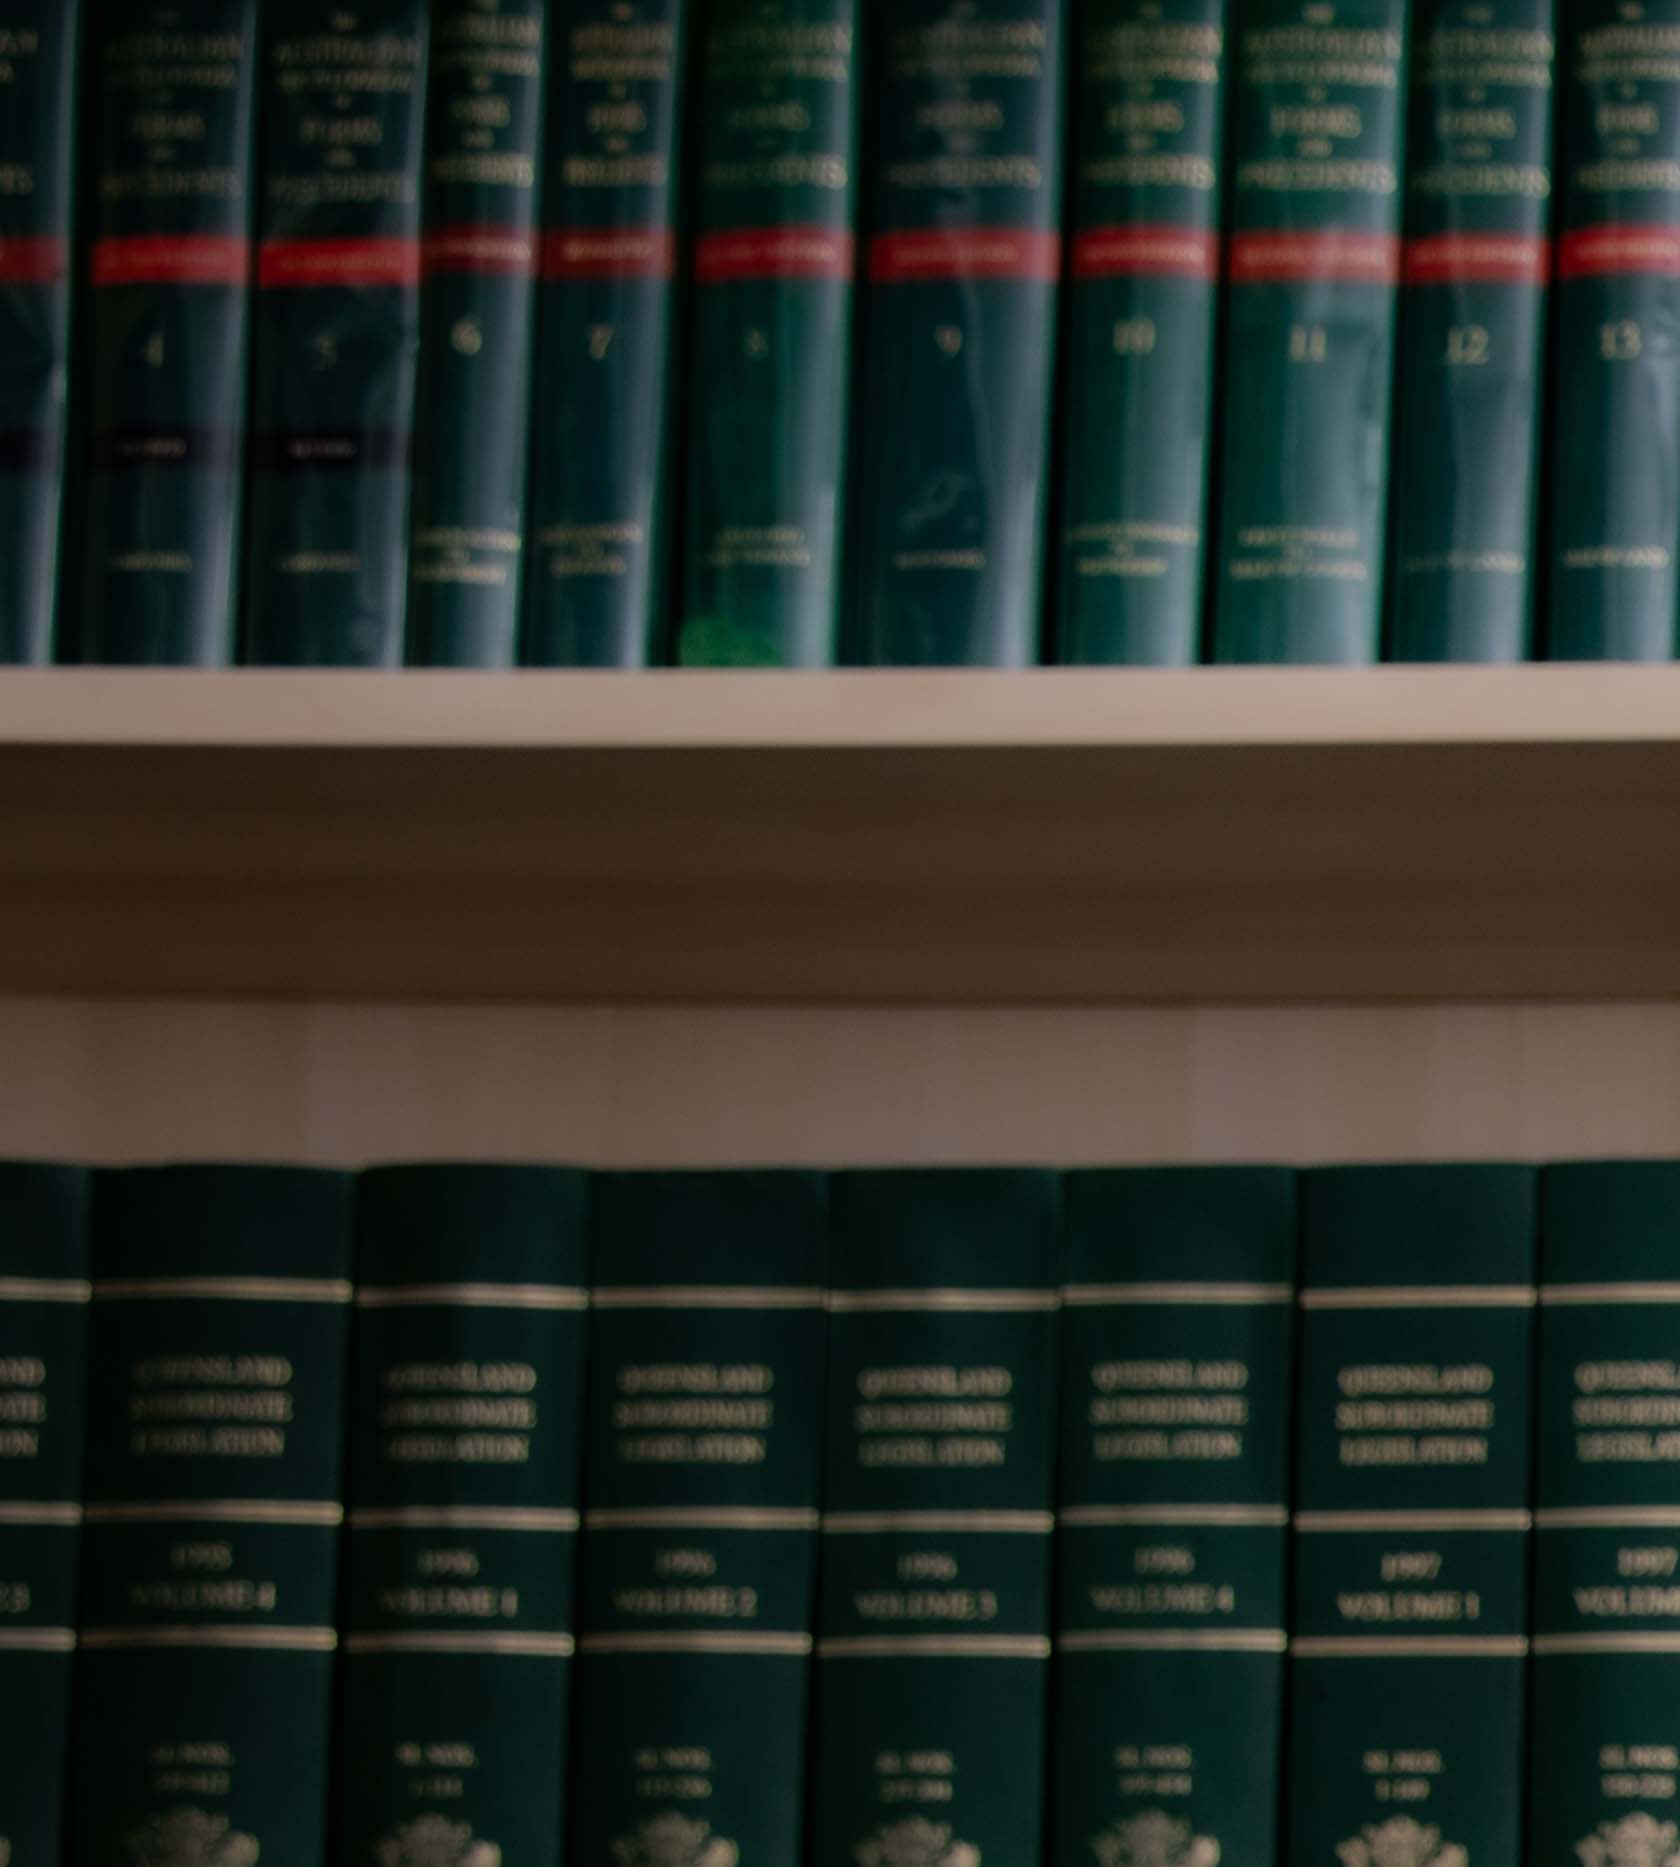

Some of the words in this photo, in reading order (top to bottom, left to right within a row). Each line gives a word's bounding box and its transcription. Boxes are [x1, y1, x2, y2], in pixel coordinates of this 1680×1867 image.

[450, 316, 483, 357] 6
[587, 323, 615, 360] 7
[933, 324, 962, 357] 9
[1113, 320, 1155, 354] 10
[1290, 325, 1326, 363] 11
[1447, 325, 1490, 365] 12
[1600, 321, 1641, 359] 13
[616, 1362, 774, 1393] QUEENSLAND
[857, 1365, 1012, 1398] QUEENSLAND
[1090, 1359, 1248, 1391] QUEENSLAND
[1337, 1363, 1494, 1396] QUEENSLAND
[1093, 1430, 1242, 1460] LEGISLATION
[1339, 1435, 1488, 1466] LEGISLATION
[1380, 1552, 1442, 1582] 1997
[1616, 1545, 1679, 1577] 1997
[610, 1586, 737, 1617] VOLUME
[738, 1586, 758, 1617] 2
[852, 1590, 975, 1620] VOLUME
[977, 1589, 998, 1620] 3
[1091, 1584, 1216, 1614] VOLUME
[1218, 1584, 1235, 1614] 4
[1337, 1591, 1463, 1622] VOLUME
[1465, 1591, 1480, 1621] 1
